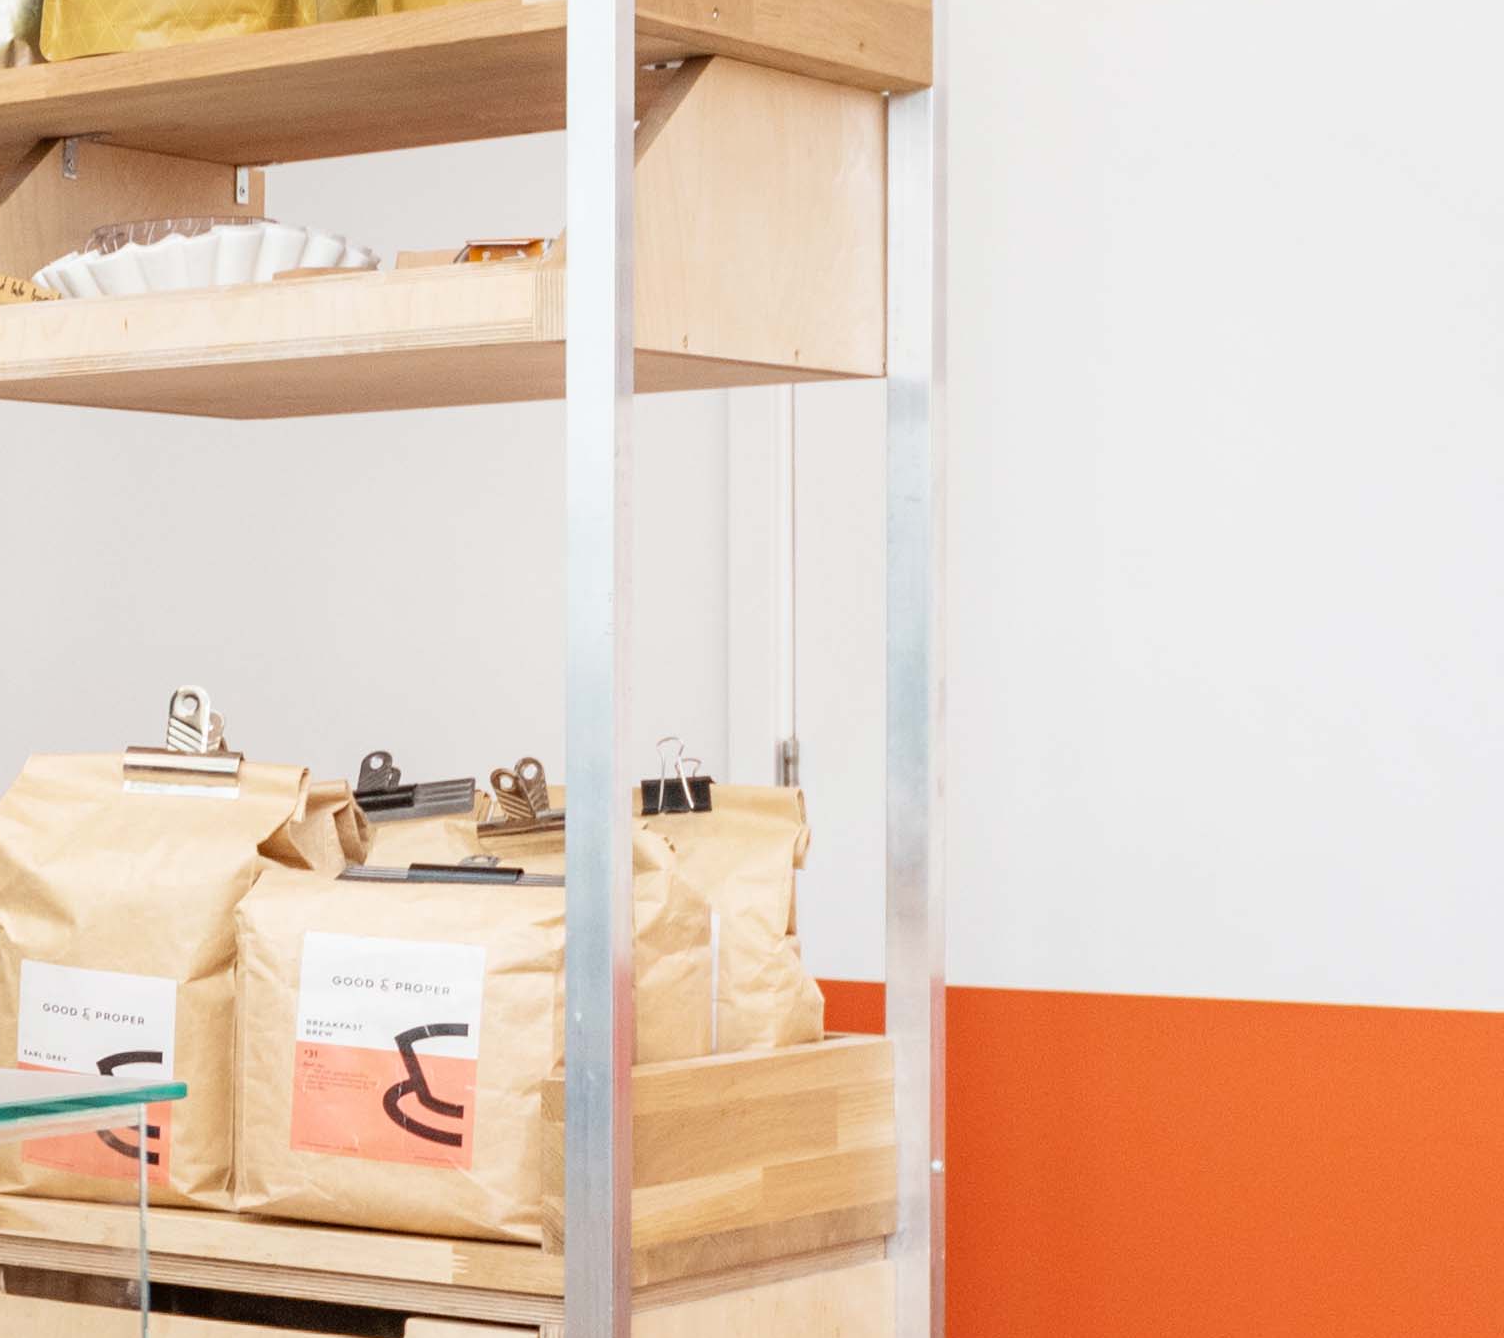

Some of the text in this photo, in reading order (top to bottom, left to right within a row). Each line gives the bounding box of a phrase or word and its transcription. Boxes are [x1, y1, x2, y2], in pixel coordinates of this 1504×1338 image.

[332, 975, 451, 995] GOOD PROPER
[42, 1002, 145, 1025] GOOD PROPER
[306, 1018, 364, 1031] BREAKFAST
[305, 1029, 333, 1037] BREW
